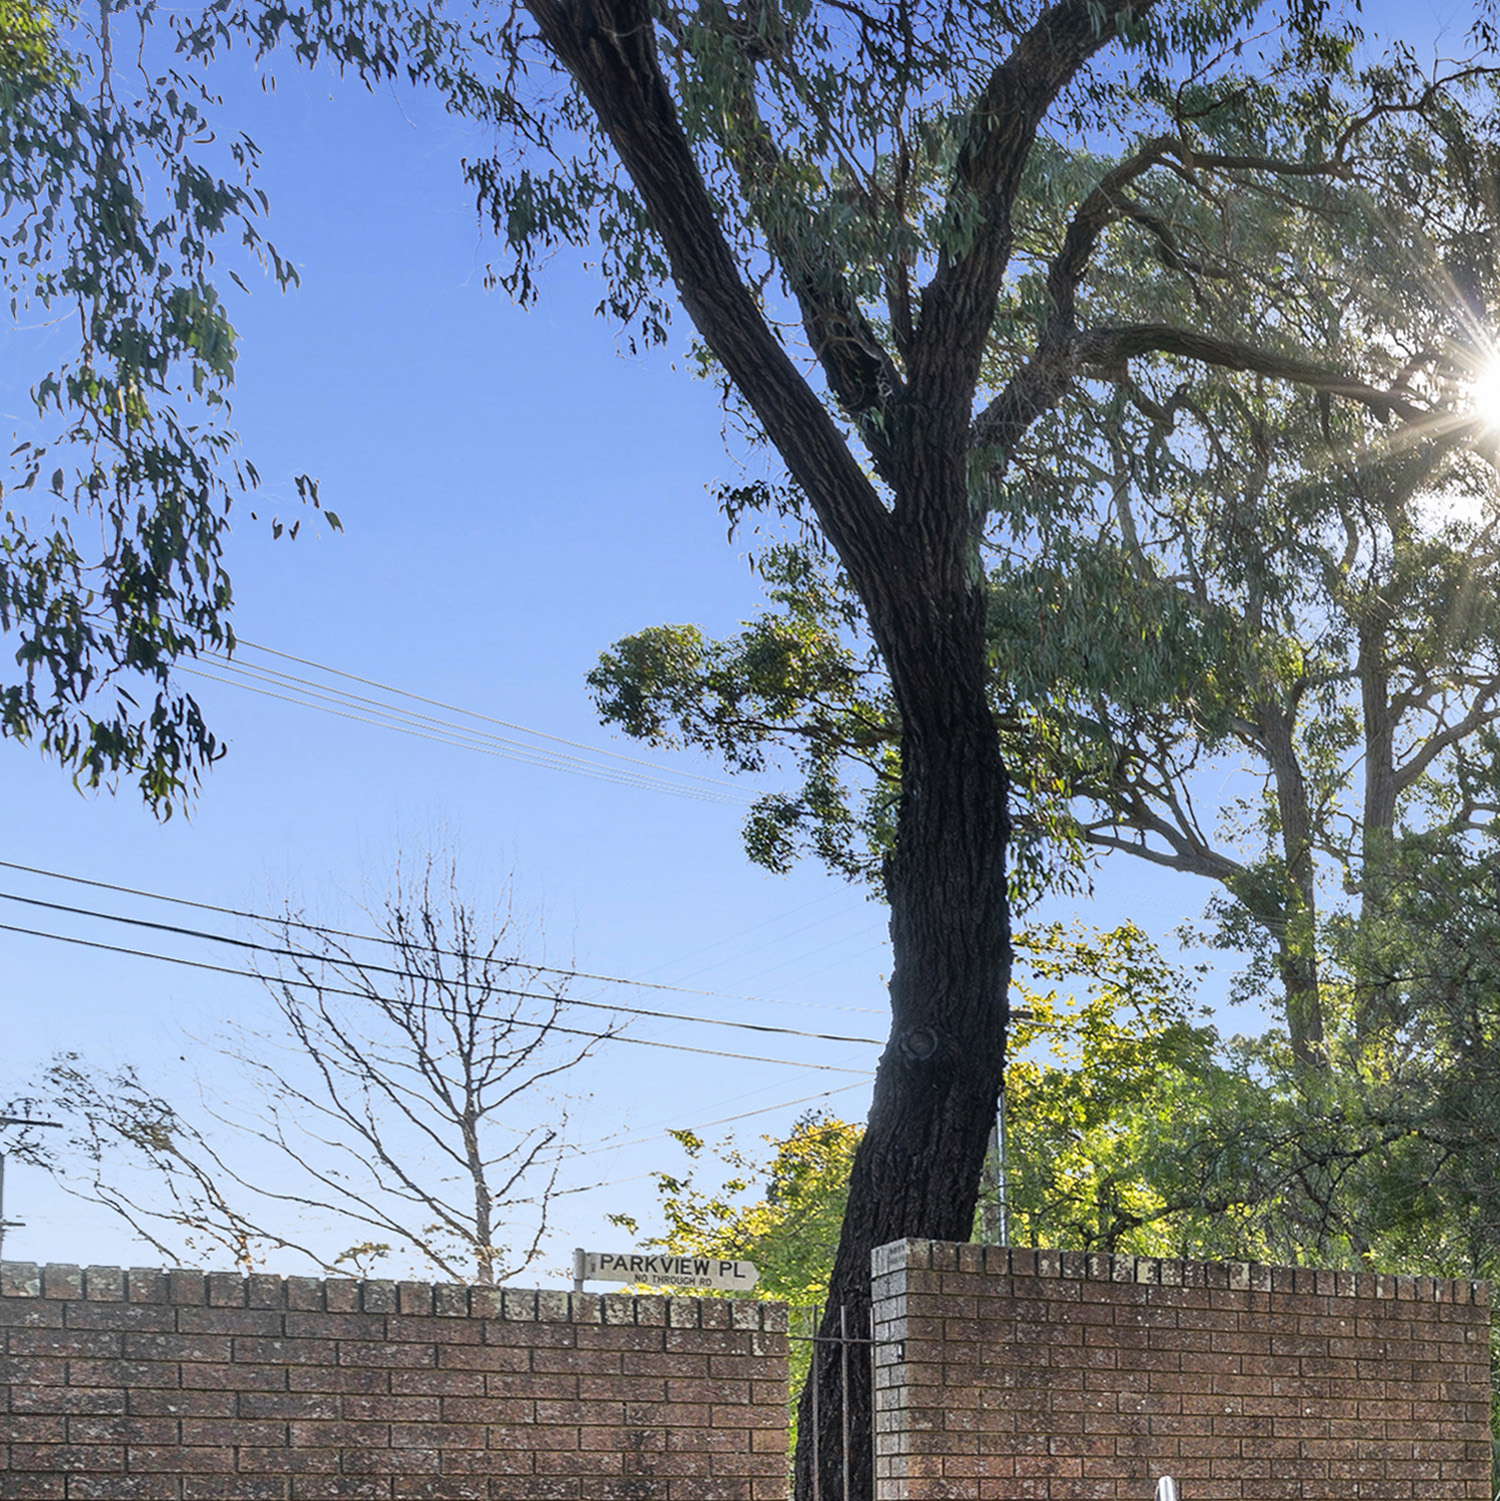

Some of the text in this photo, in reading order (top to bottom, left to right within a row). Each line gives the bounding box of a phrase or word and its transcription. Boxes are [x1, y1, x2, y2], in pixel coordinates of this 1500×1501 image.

[599, 1253, 710, 1276] PARKVIEW
[719, 1261, 746, 1278] PL
[634, 1274, 648, 1283] NO
[652, 1275, 696, 1286] THROUGH
